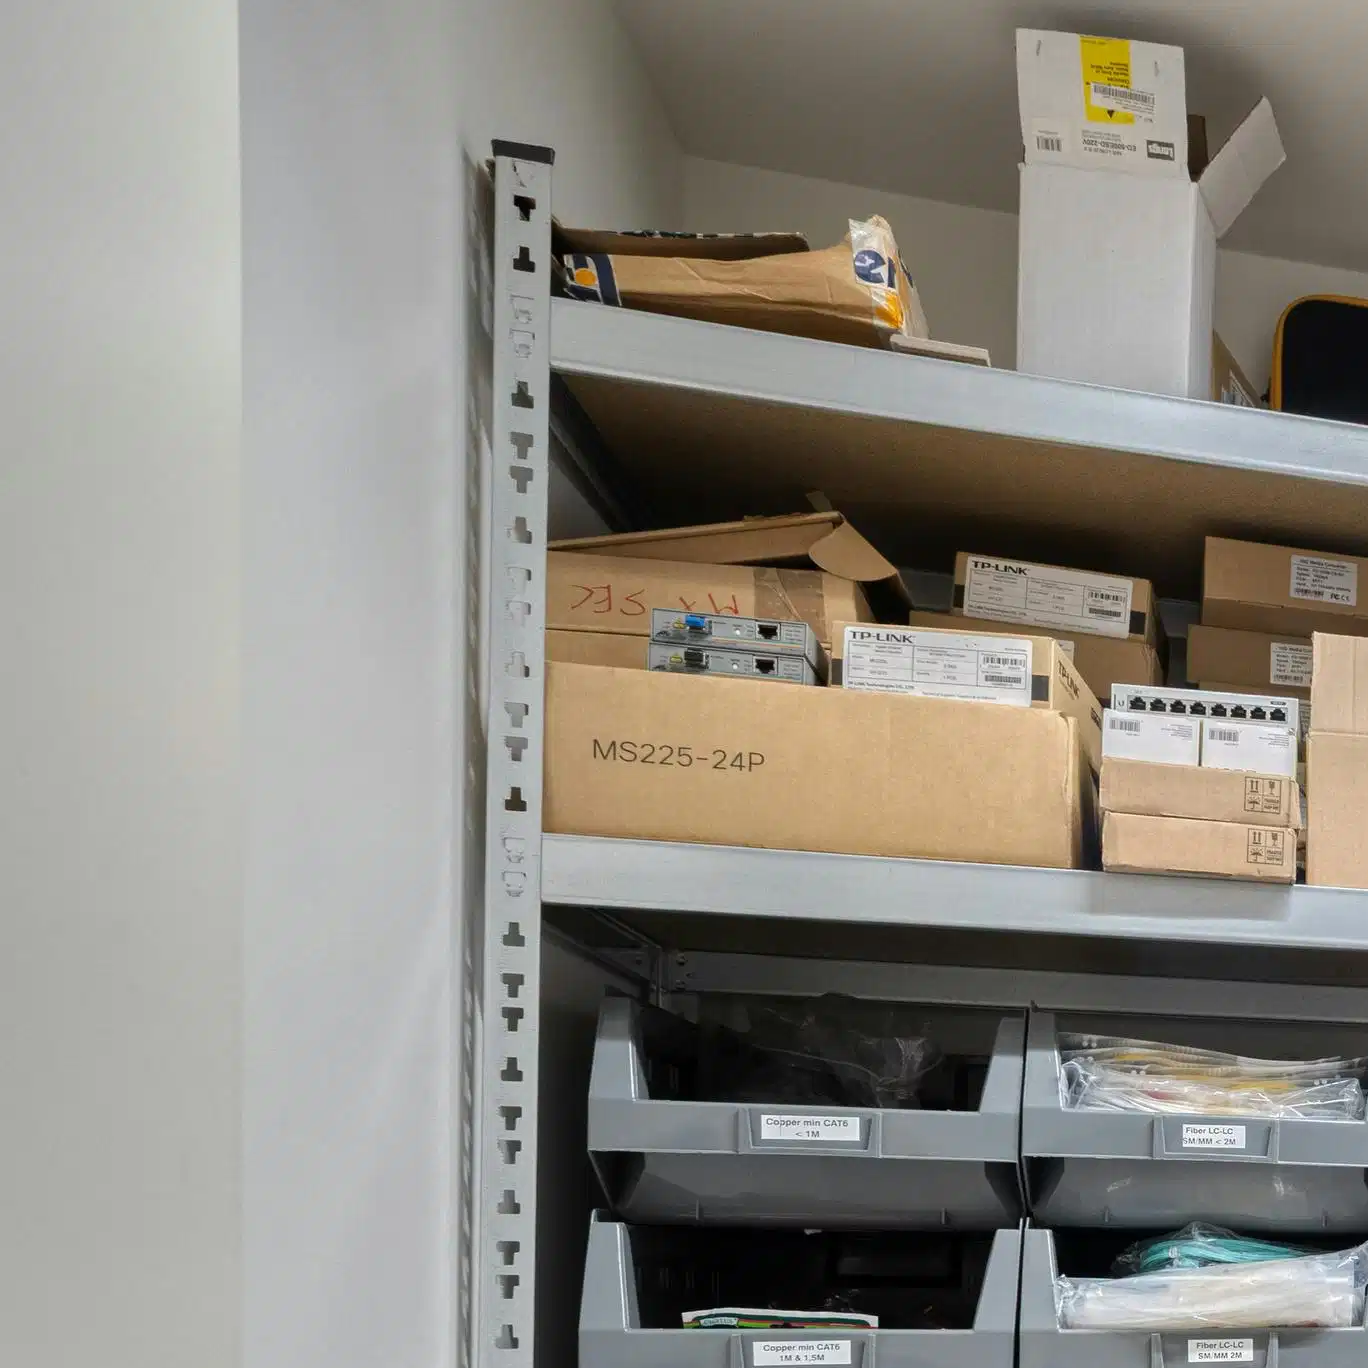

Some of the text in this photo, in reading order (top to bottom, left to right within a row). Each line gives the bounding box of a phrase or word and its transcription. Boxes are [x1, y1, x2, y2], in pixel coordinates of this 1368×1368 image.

[972, 560, 1028, 575] TP-LINK
[850, 631, 913, 643] TP-LINK
[593, 739, 765, 772] MS225-24P
[766, 1118, 849, 1128] Copper min CAT6
[806, 1130, 820, 1138] 1M
[1208, 1127, 1234, 1135] LC-LC
[763, 1343, 841, 1353] Copper min CAT6
[1219, 1341, 1244, 1349] LC-LC
[780, 1354, 792, 1362] 1M
[795, 1354, 801, 1362] &
[1230, 1351, 1243, 1359] 2M
